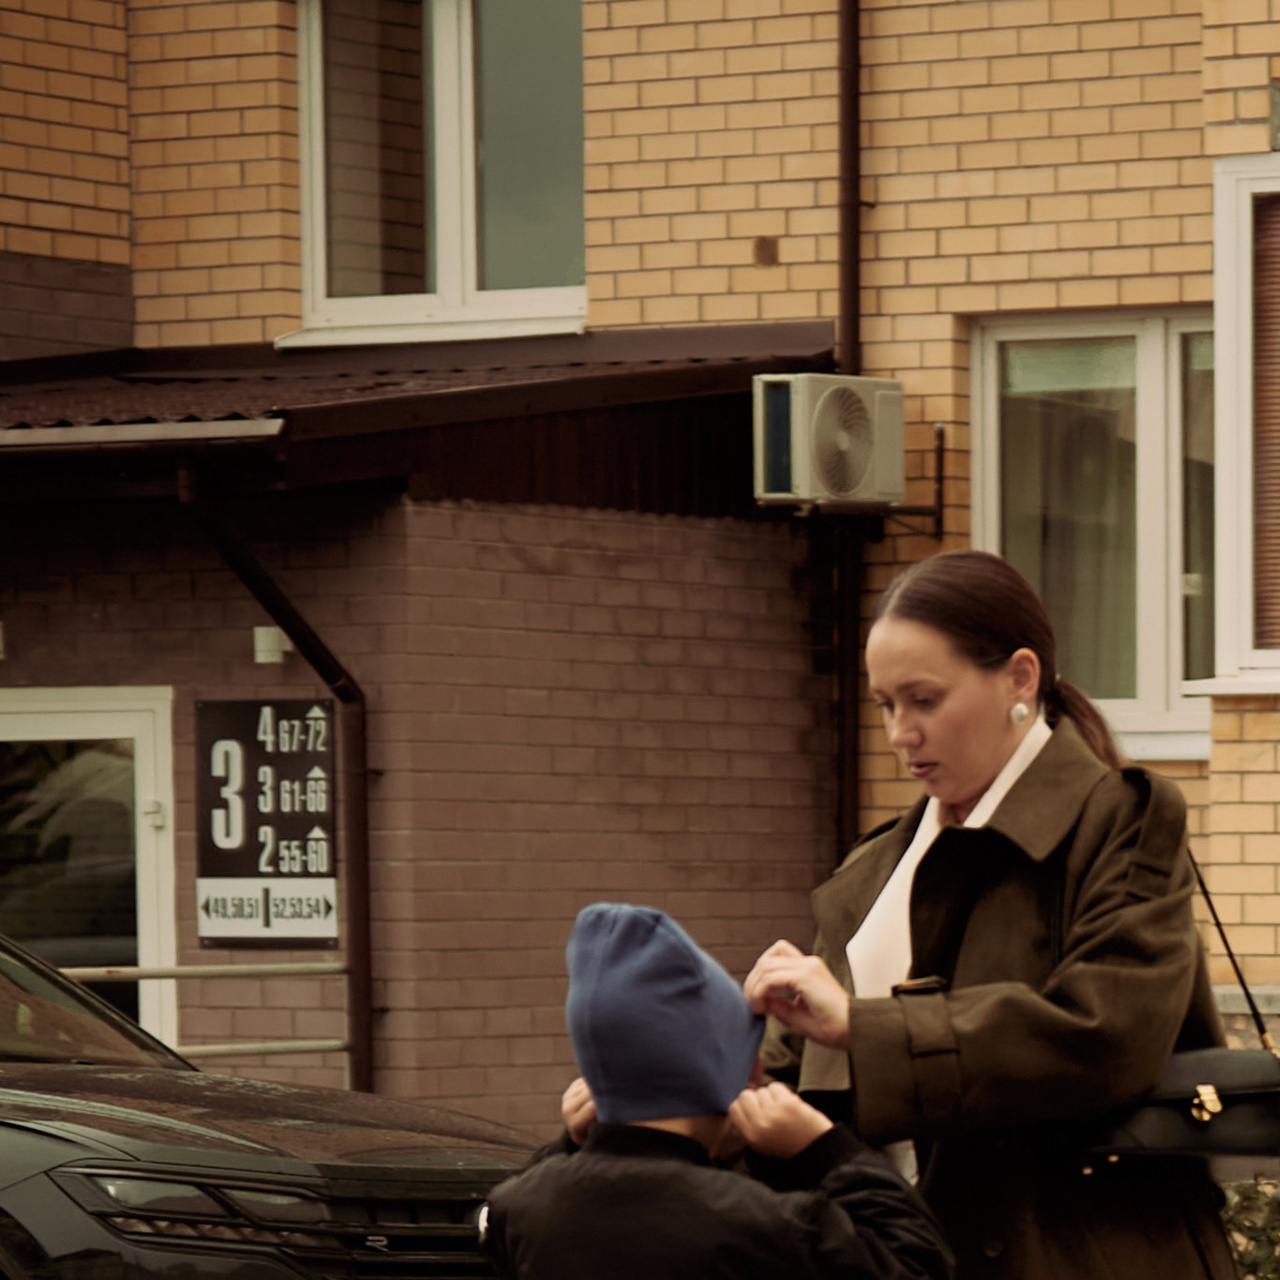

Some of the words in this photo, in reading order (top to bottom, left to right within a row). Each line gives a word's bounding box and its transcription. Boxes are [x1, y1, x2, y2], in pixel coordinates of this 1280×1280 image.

[257, 706, 274, 752] 4
[278, 719, 327, 752] 67-72
[211, 739, 243, 849] 3
[257, 765, 273, 813] 3
[279, 780, 327, 813] 61-66
[257, 825, 274, 873] 2
[278, 840, 329, 873] 55-60
